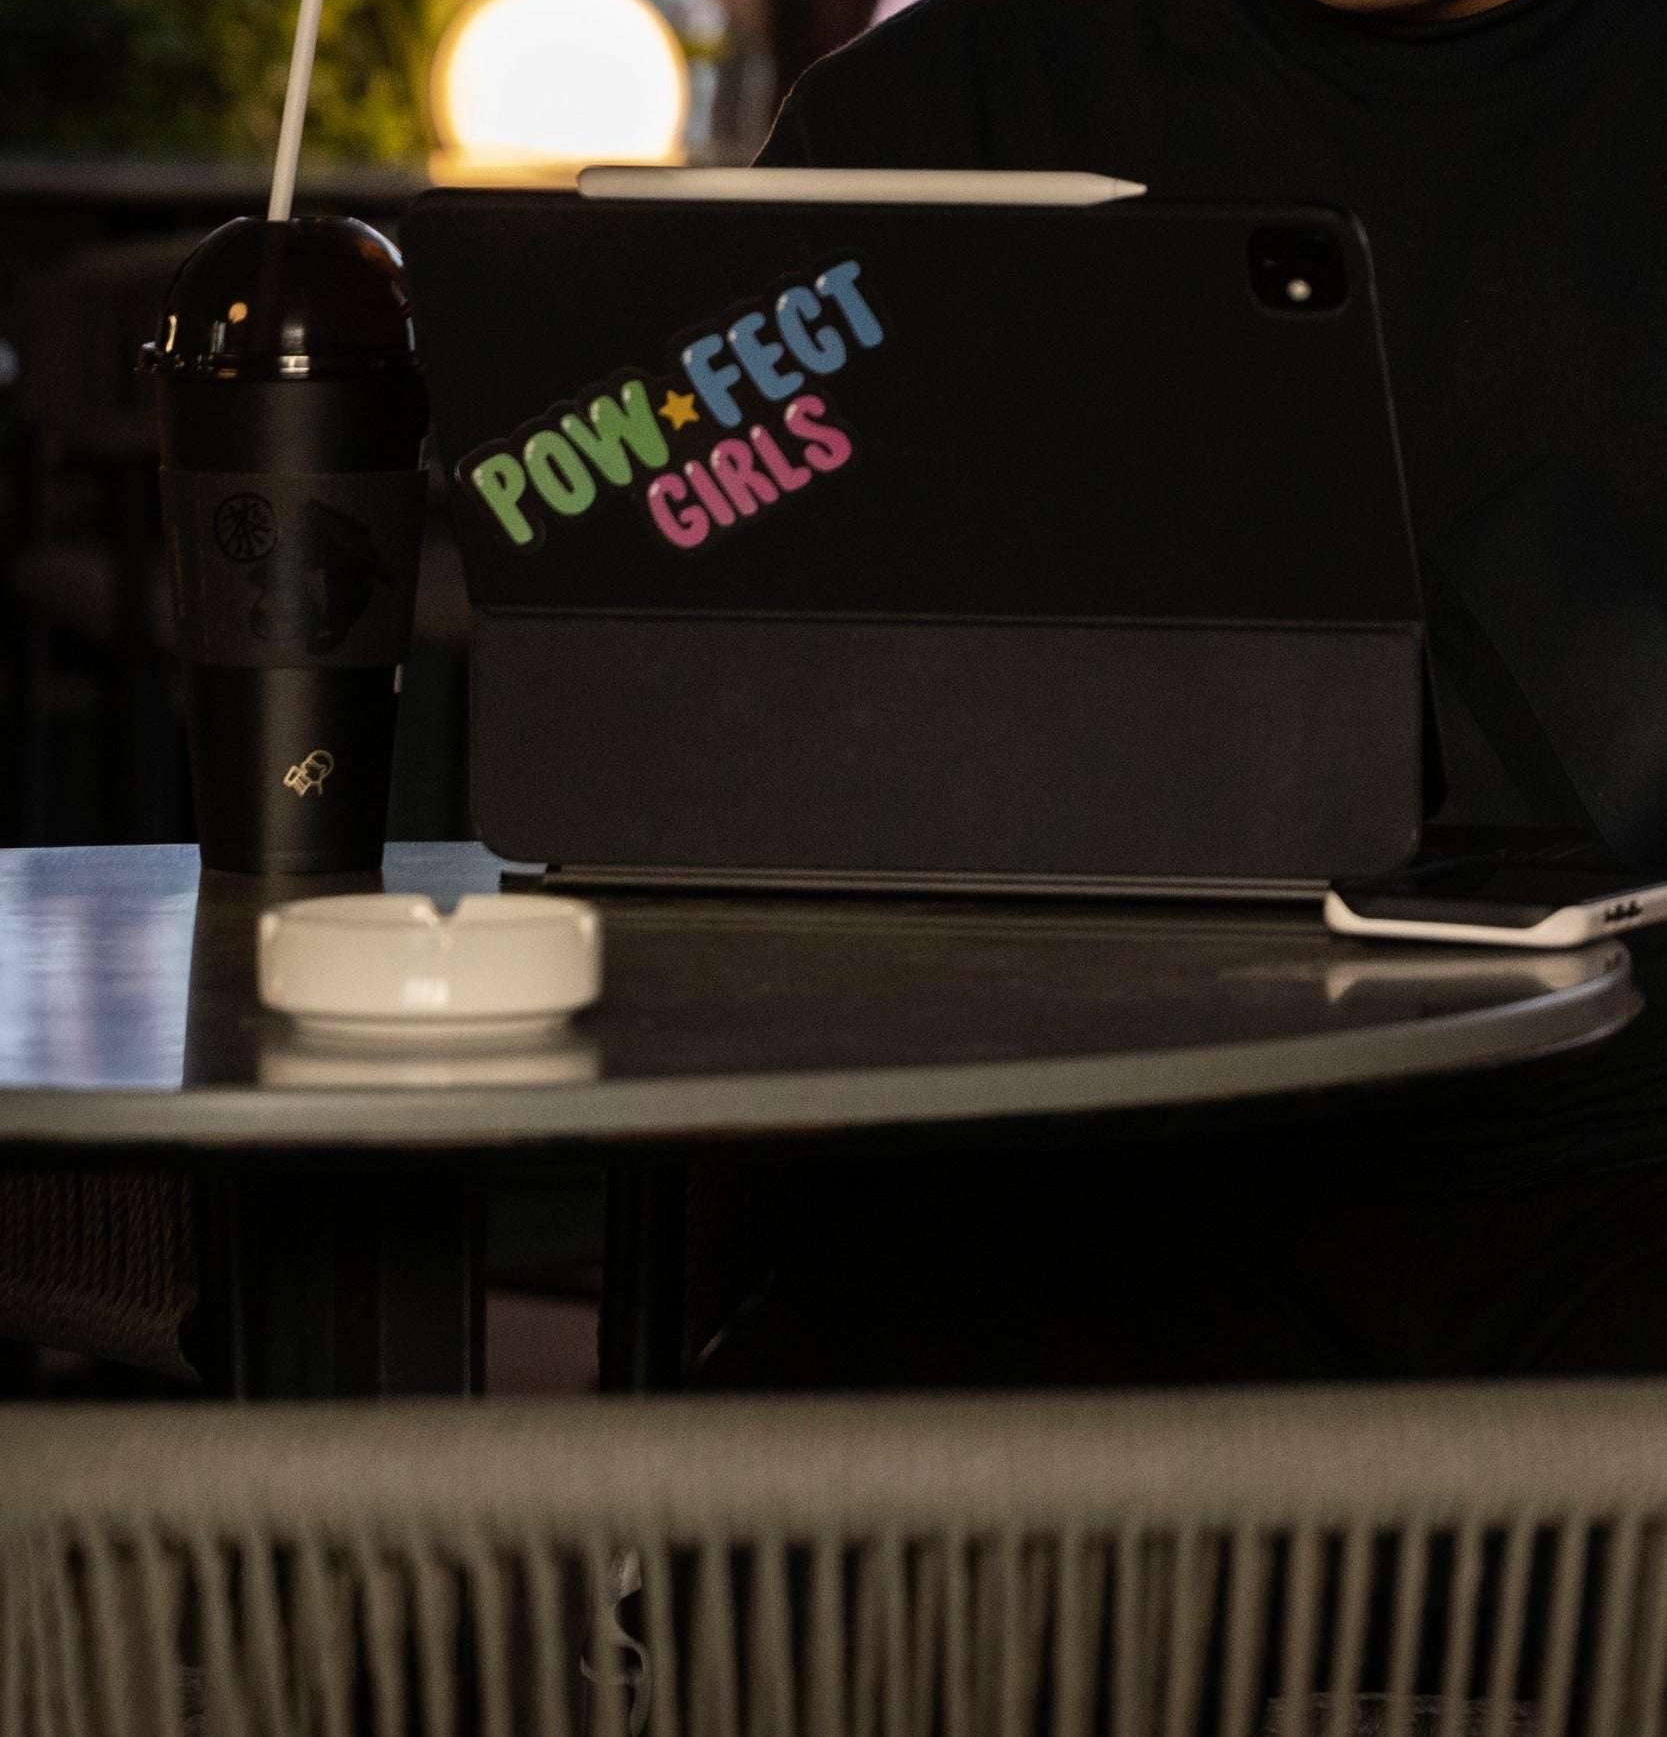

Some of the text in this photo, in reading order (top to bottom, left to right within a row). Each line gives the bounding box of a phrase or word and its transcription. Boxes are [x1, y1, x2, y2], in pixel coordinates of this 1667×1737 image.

[470, 259, 885, 546] POW FECT
[646, 393, 853, 549] GIRLS
[220, 498, 273, 557] 茶
